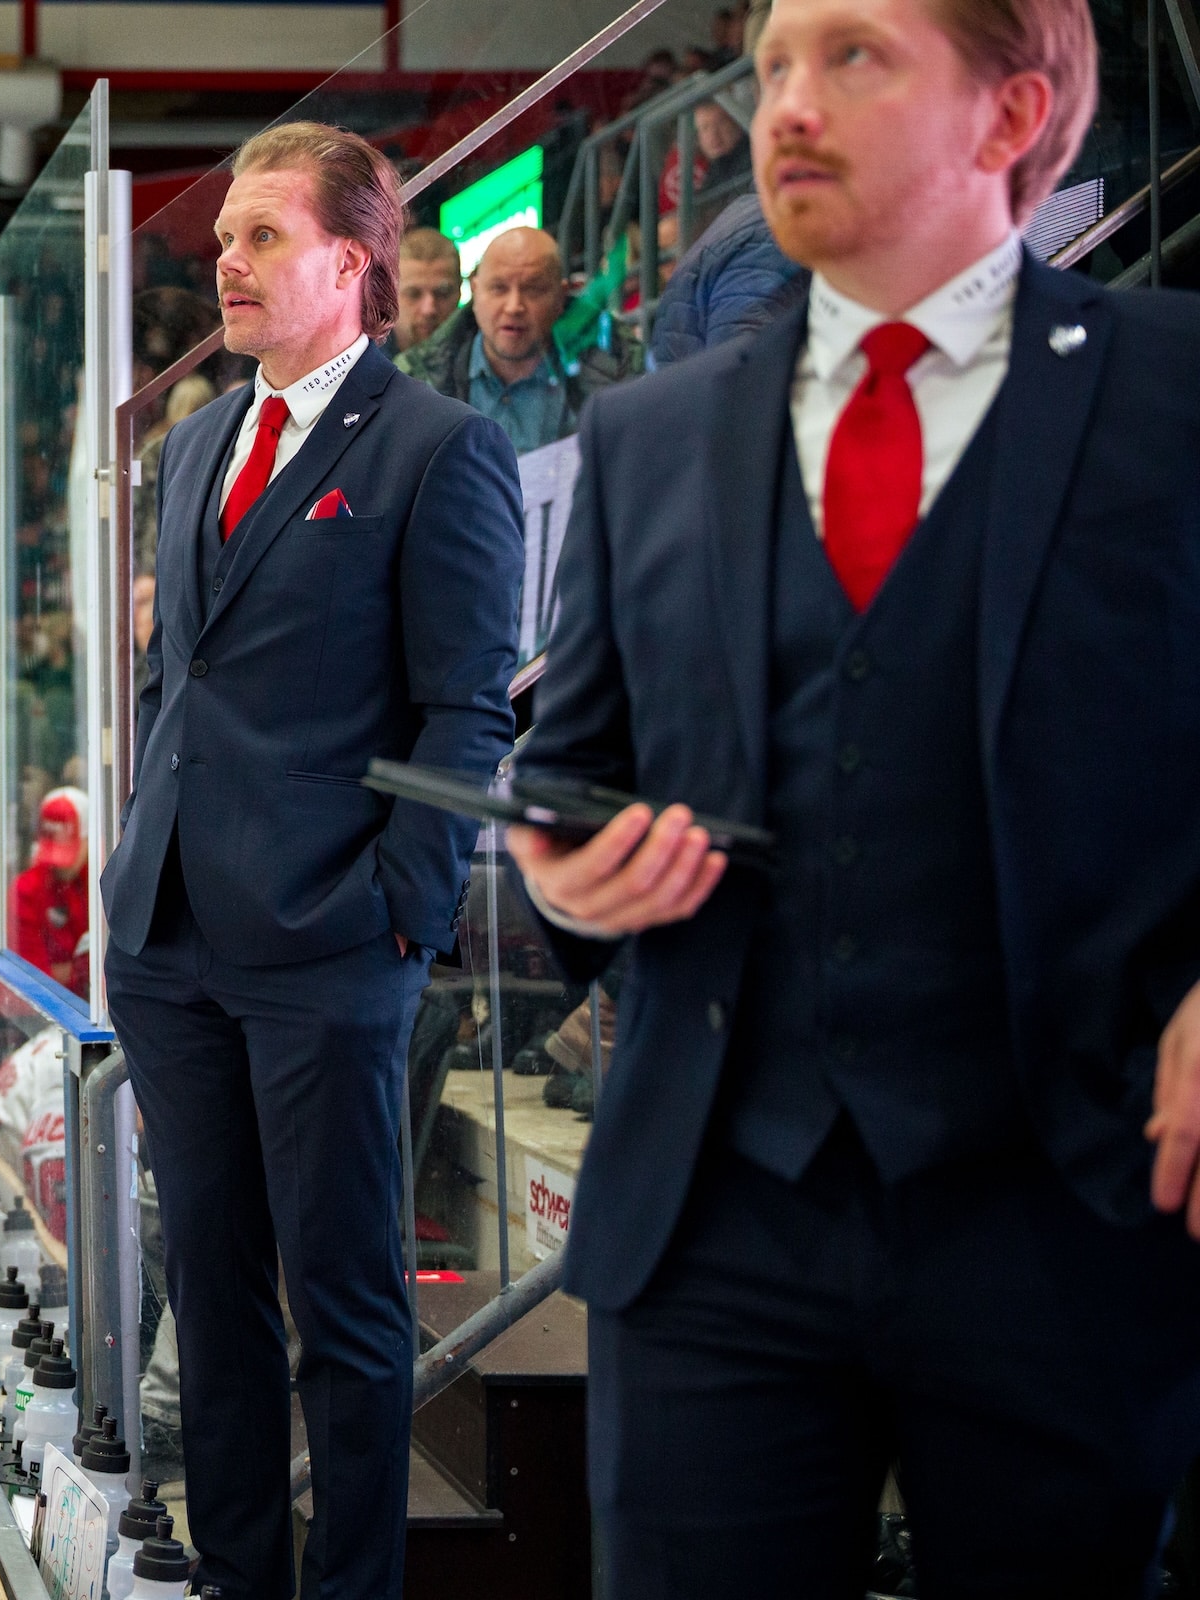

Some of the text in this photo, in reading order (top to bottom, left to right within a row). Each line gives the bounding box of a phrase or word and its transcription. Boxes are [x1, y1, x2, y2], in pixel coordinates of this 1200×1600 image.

[303, 353, 352, 393] TED BAKER
[320, 370, 346, 390] LONDON
